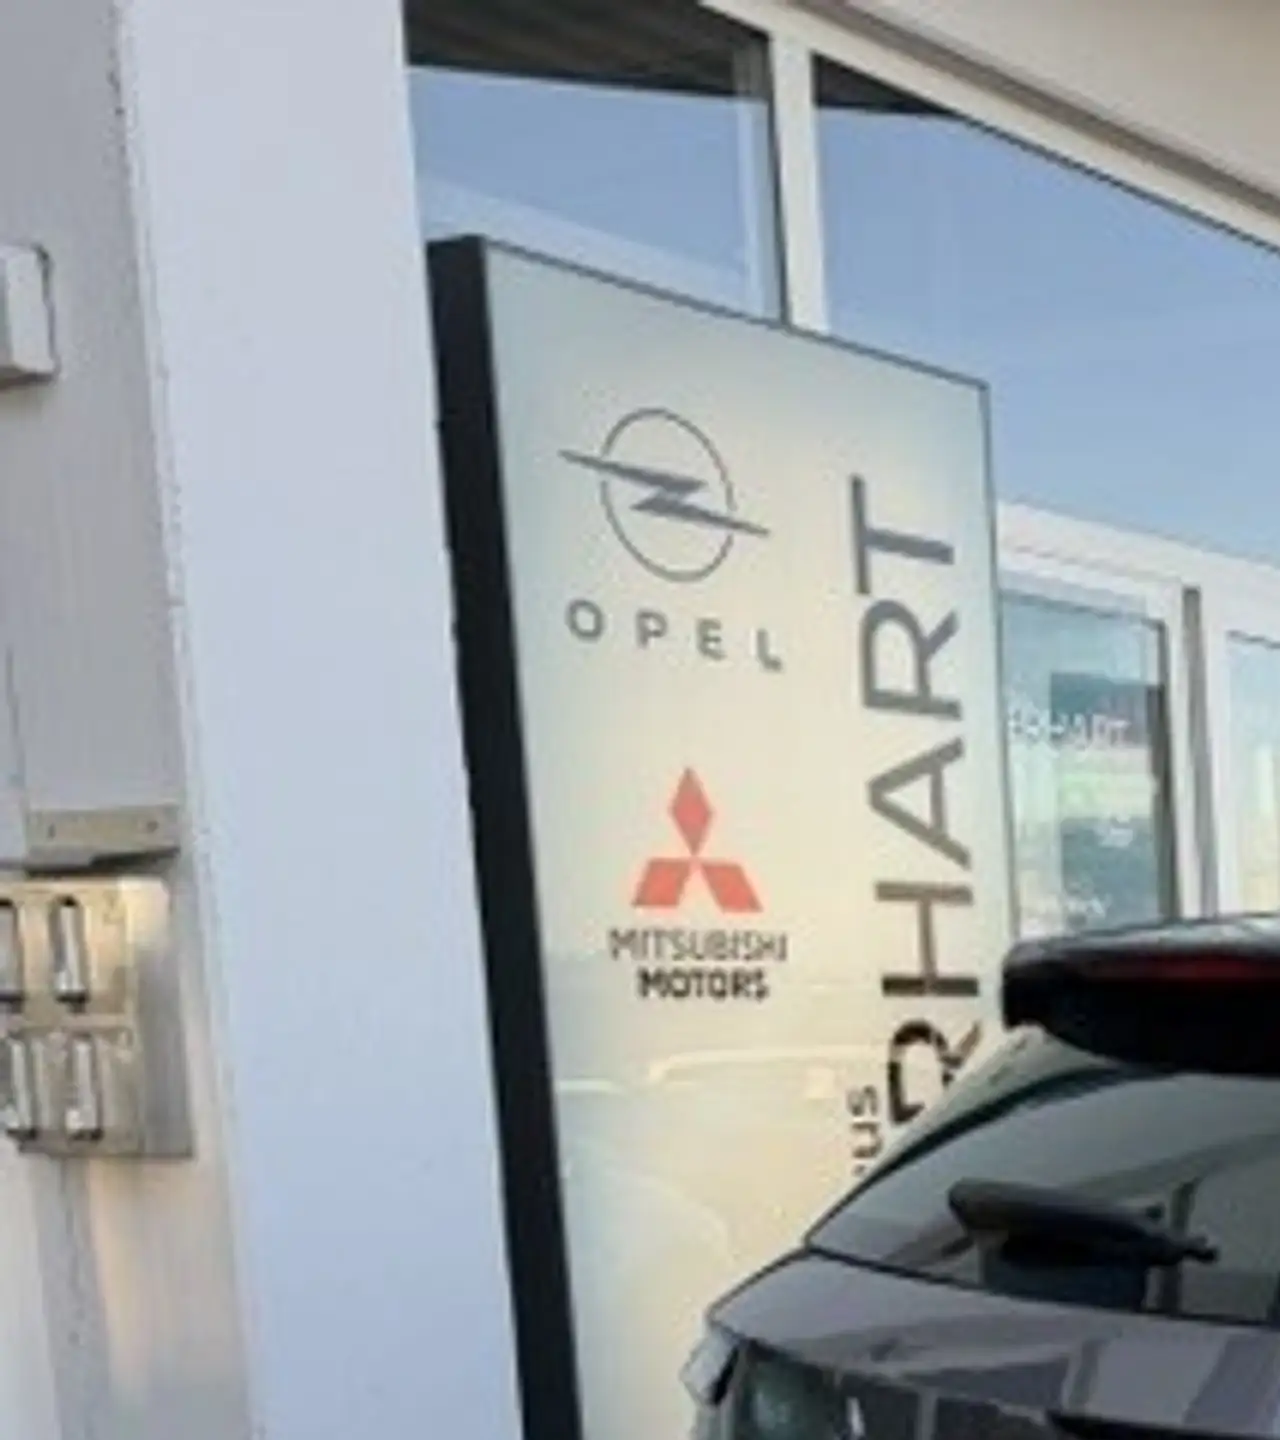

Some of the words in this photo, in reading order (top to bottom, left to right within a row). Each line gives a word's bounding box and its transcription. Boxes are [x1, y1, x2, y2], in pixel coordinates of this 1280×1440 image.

[567, 600, 786, 672] OPEL
[608, 926, 789, 963] MITSUBISHI
[636, 967, 771, 1001] MOTORS
